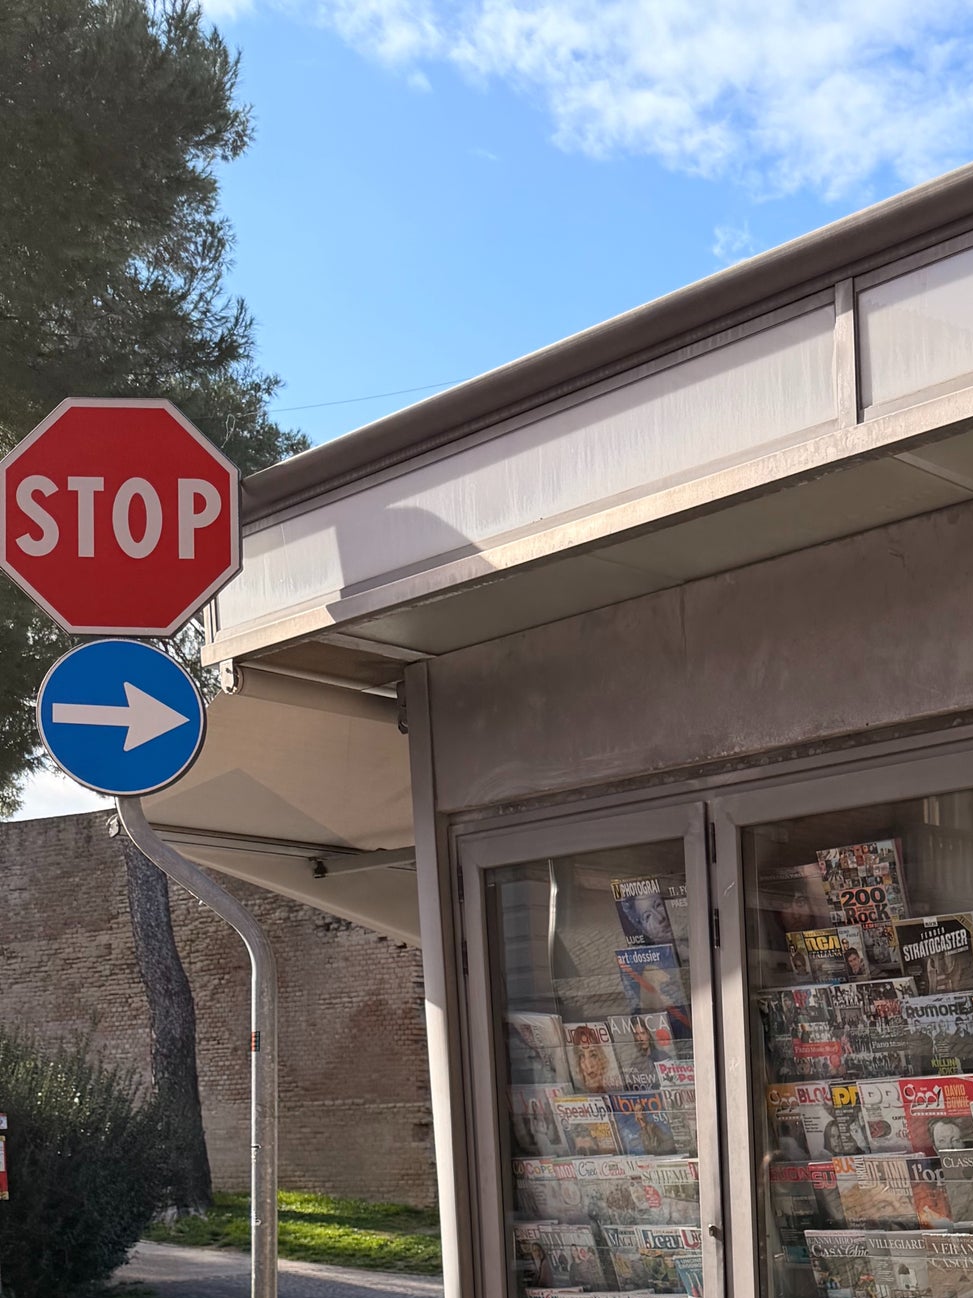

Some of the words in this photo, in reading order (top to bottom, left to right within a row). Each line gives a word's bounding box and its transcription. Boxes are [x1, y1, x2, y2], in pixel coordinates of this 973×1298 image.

[15, 475, 222, 560] STOP
[840, 887, 886, 907] 200
[626, 934, 646, 945] LUCE
[902, 928, 969, 962] STRATOCASTER
[632, 950, 660, 963] dossier
[905, 1002, 968, 1019] RUMORE
[610, 1015, 670, 1035] AMICA
[632, 1072, 656, 1084] NEW
[944, 1084, 966, 1097] DAVID
[946, 1096, 970, 1109] BOWIE
[811, 1243, 843, 1258] CASA
